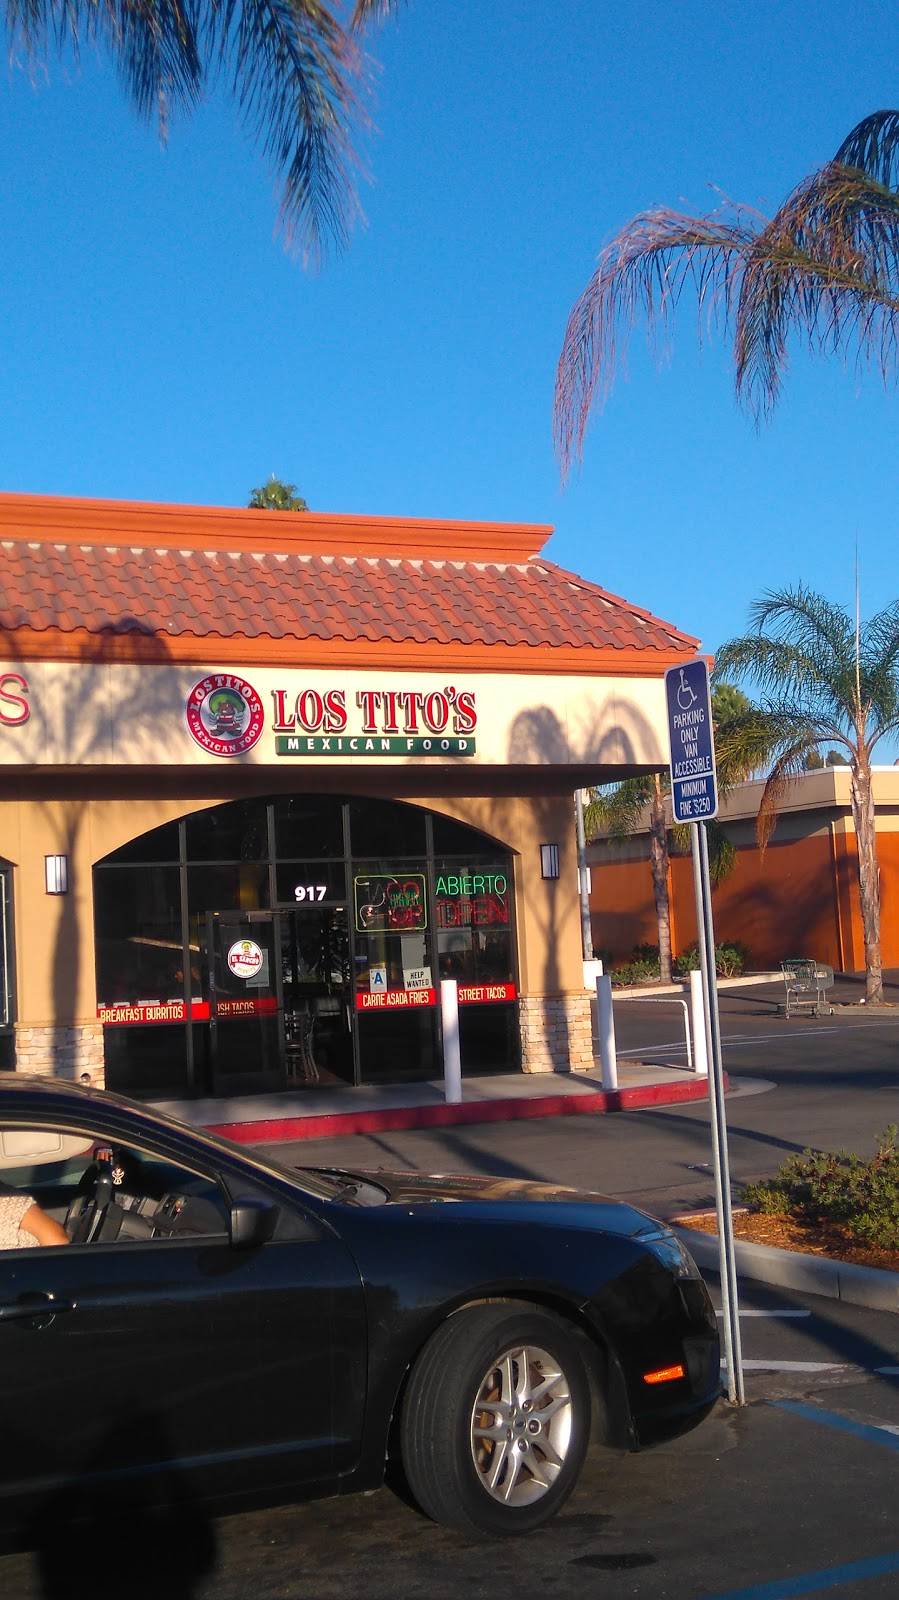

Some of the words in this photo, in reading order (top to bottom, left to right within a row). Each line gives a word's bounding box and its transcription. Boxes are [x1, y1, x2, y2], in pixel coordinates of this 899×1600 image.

[189, 680, 213, 711] LOS
[214, 675, 261, 713] TITO'S
[271, 689, 347, 733] LOS
[356, 686, 478, 735] TITO'S
[673, 708, 705, 728] PARKING
[192, 721, 237, 752] MEXICAN
[239, 723, 259, 748] FOOD
[680, 727, 699, 742] ONLY
[287, 738, 391, 751] MEXICAN
[407, 738, 468, 751] FOOD
[684, 743, 698, 758] VAN
[674, 756, 711, 776] ACCESSIBLE
[681, 779, 707, 798] MINIMUM
[680, 800, 692, 816] FINE
[693, 797, 710, 815] $250
[435, 875, 507, 895] ABIERTO
[294, 886, 327, 901] 917
[374, 972, 383, 985] A
[407, 979, 429, 988] WANTED
[410, 971, 424, 980] HELP
[362, 993, 385, 1007] CARNE
[386, 992, 408, 1005] ASADA
[409, 991, 429, 1004] FRIES
[458, 987, 484, 1001] STREET
[486, 986, 506, 999] TACOS
[100, 1008, 144, 1023] BREAKFAST
[146, 1006, 184, 1020] BURRITOS
